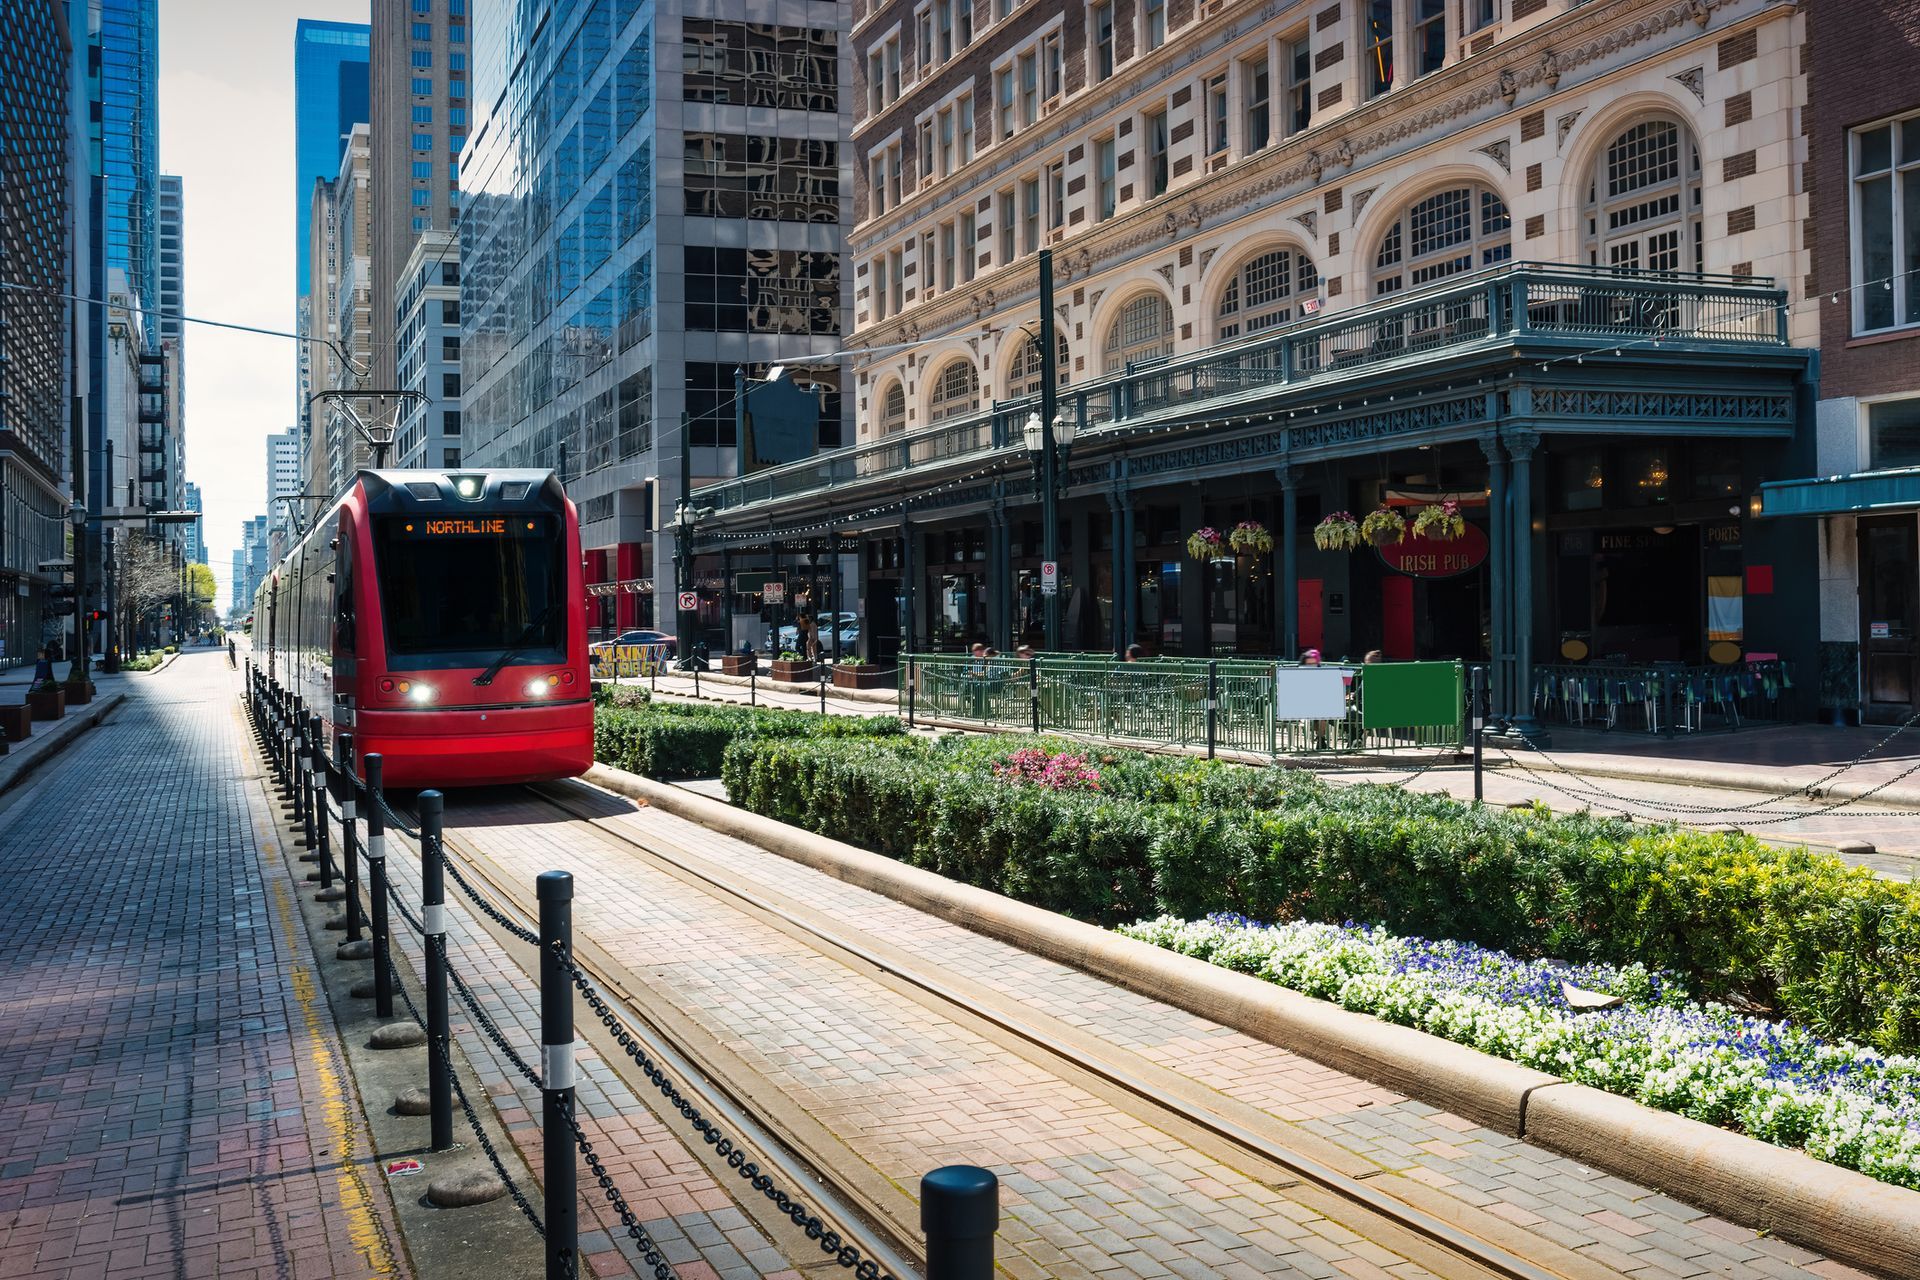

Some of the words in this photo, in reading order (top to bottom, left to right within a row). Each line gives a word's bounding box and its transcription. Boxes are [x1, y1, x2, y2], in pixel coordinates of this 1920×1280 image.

[1306, 300, 1319, 311] EXIT
[426, 520, 504, 534] NORTHLINE
[1601, 535, 1632, 549] FINE
[1400, 555, 1436, 571] IRISH
[1444, 554, 1470, 570] PUB
[593, 646, 646, 662] MAIN
